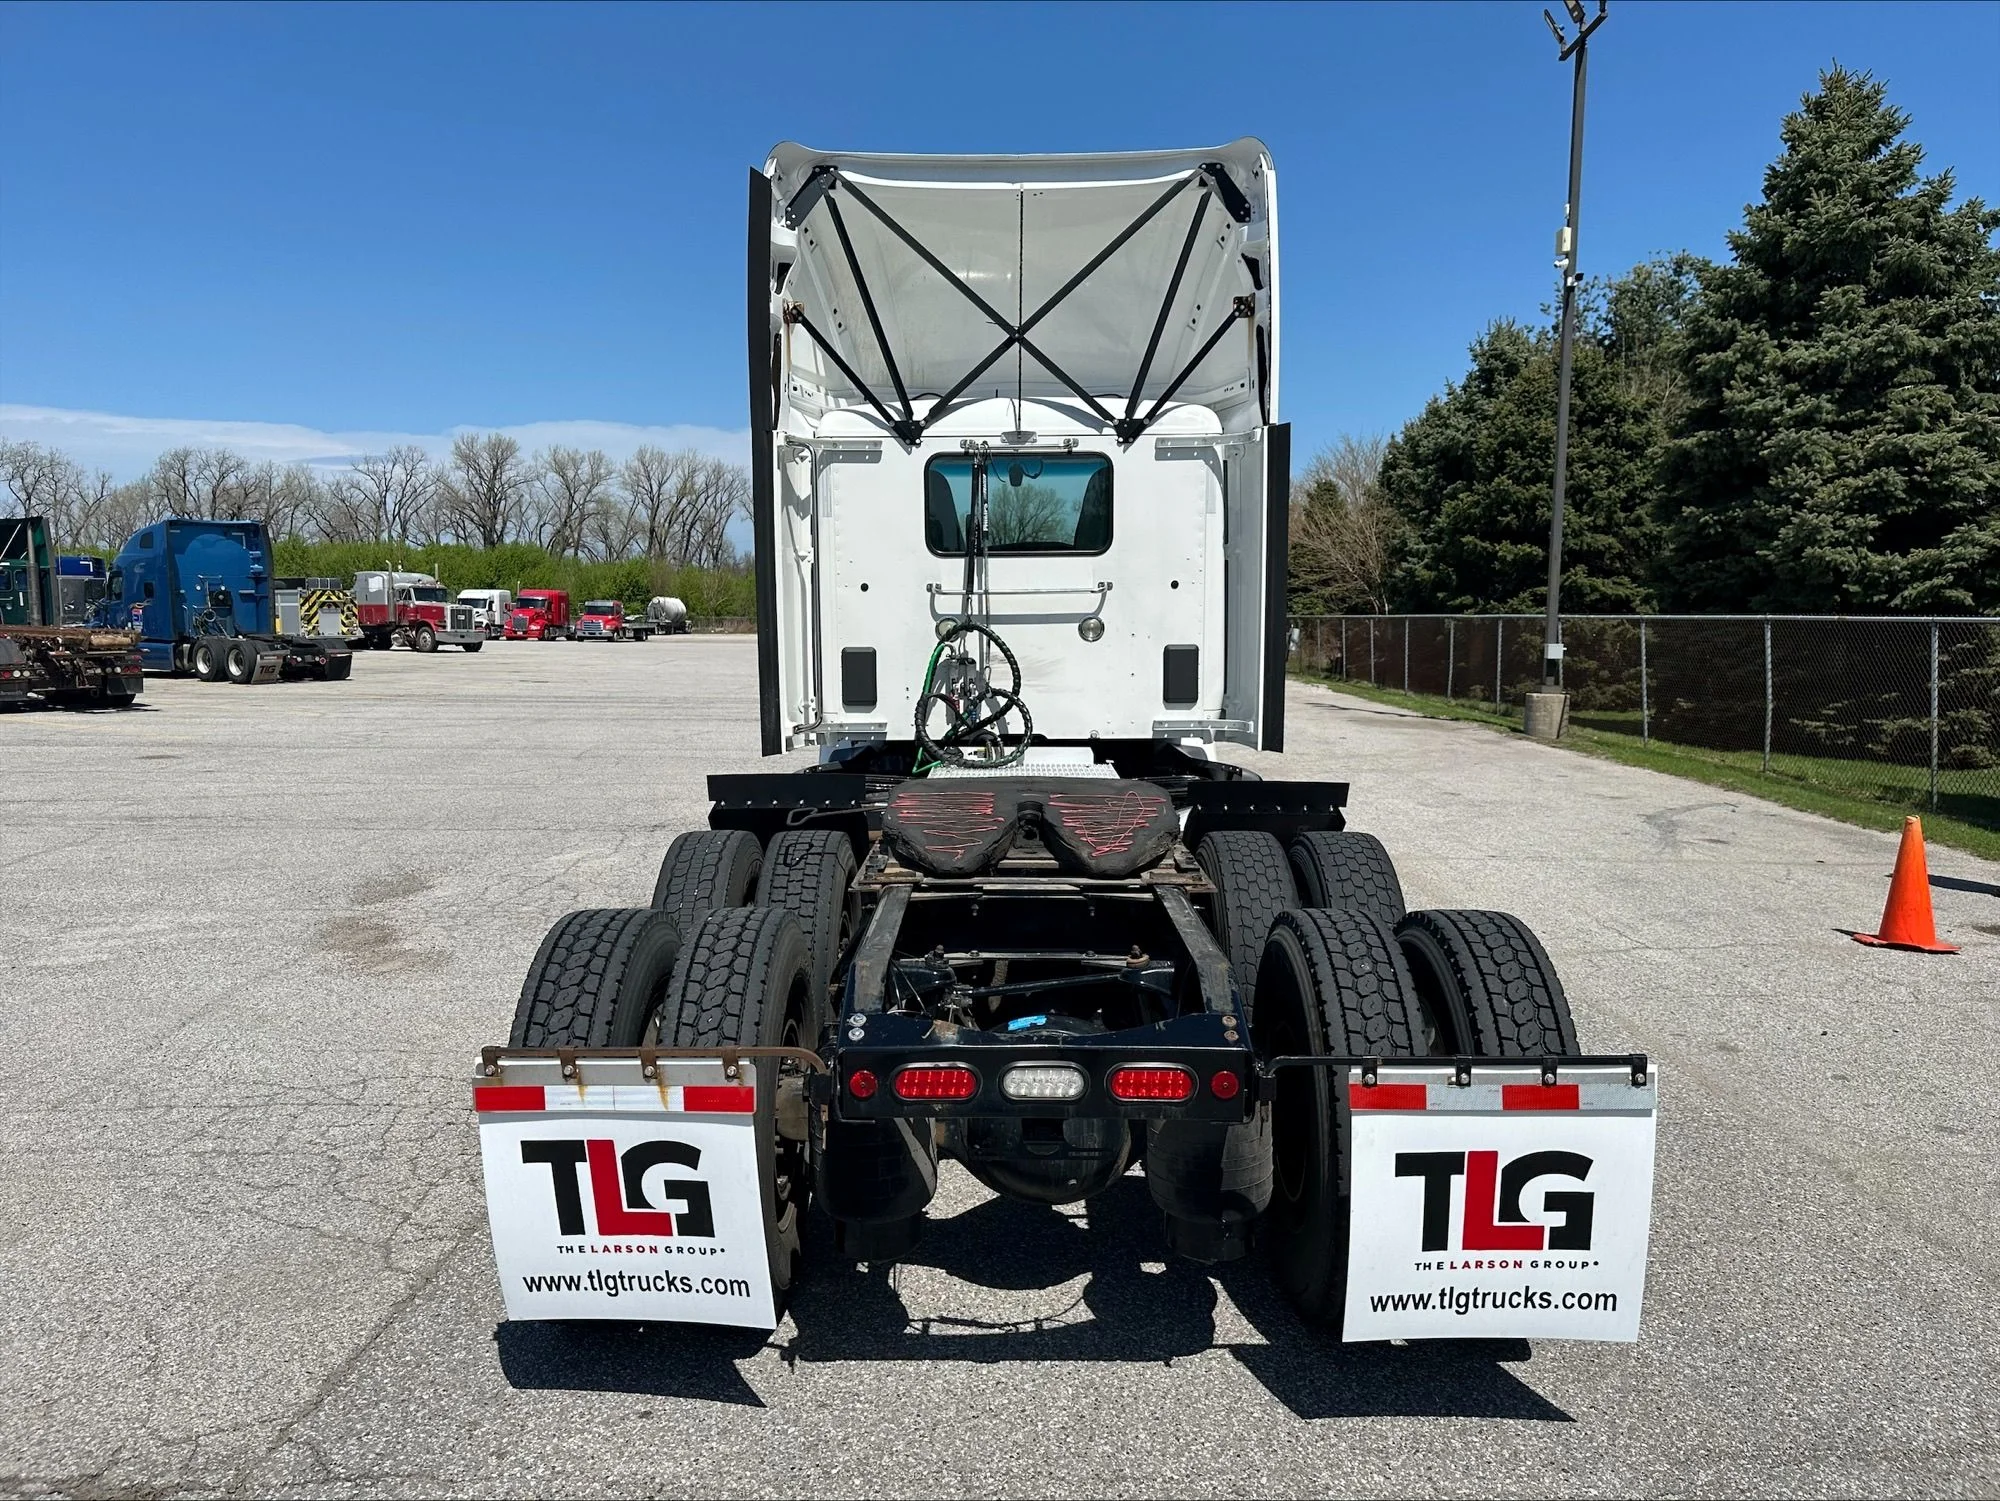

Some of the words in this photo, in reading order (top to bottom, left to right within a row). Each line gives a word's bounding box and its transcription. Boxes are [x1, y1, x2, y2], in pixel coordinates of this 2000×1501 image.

[259, 665, 277, 674] TLG
[521, 1139, 716, 1238] TLG
[1395, 1150, 1595, 1252] TLG
[557, 1245, 586, 1254] THE
[590, 1244, 659, 1254] LARSON
[1414, 1261, 1445, 1271] THE
[1449, 1259, 1523, 1270] LARSON
[522, 1268, 751, 1298] www.tlgtrucks.com
[1369, 1285, 1618, 1316] www.tlgtrucks.com
